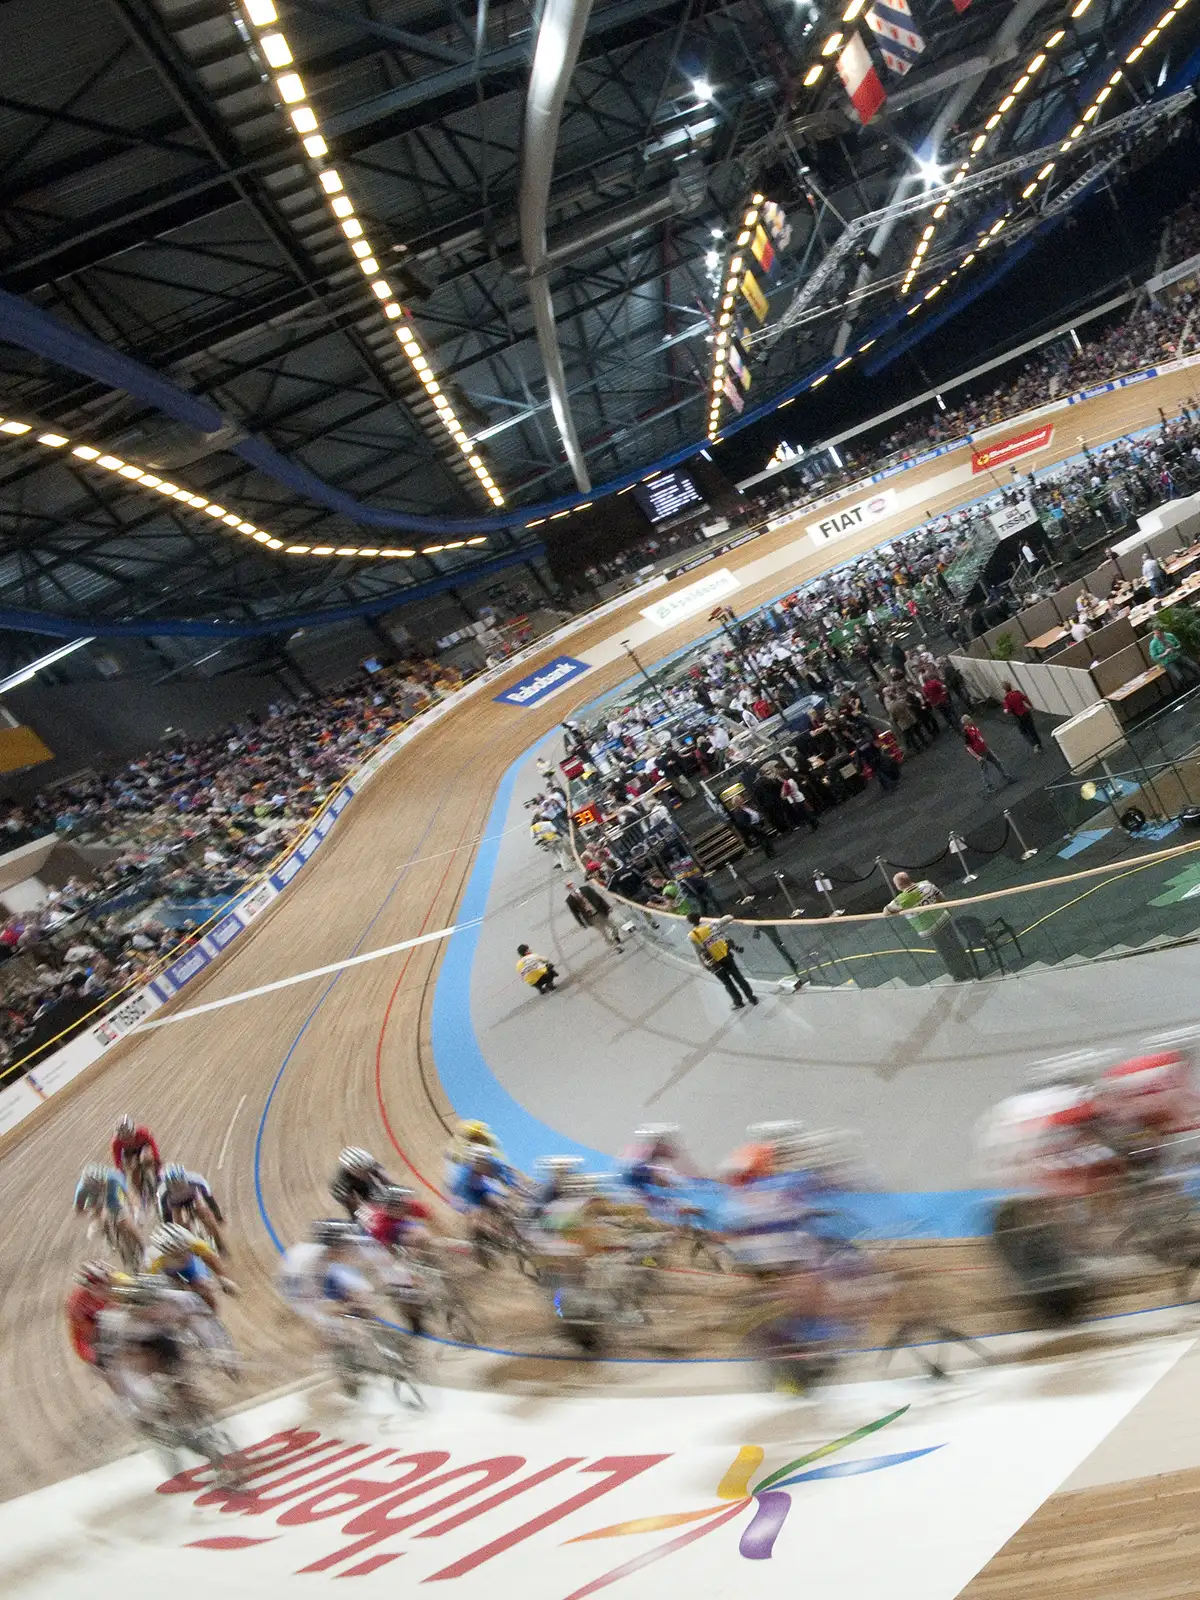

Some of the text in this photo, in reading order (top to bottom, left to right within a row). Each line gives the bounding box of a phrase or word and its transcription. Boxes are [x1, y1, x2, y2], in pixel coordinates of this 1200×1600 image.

[819, 507, 863, 538] FIAT
[998, 510, 1031, 531] TISSOT
[506, 662, 577, 702] Rabobank
[575, 809, 595, 827] 39
[155, 1425, 677, 1584] Libéma
